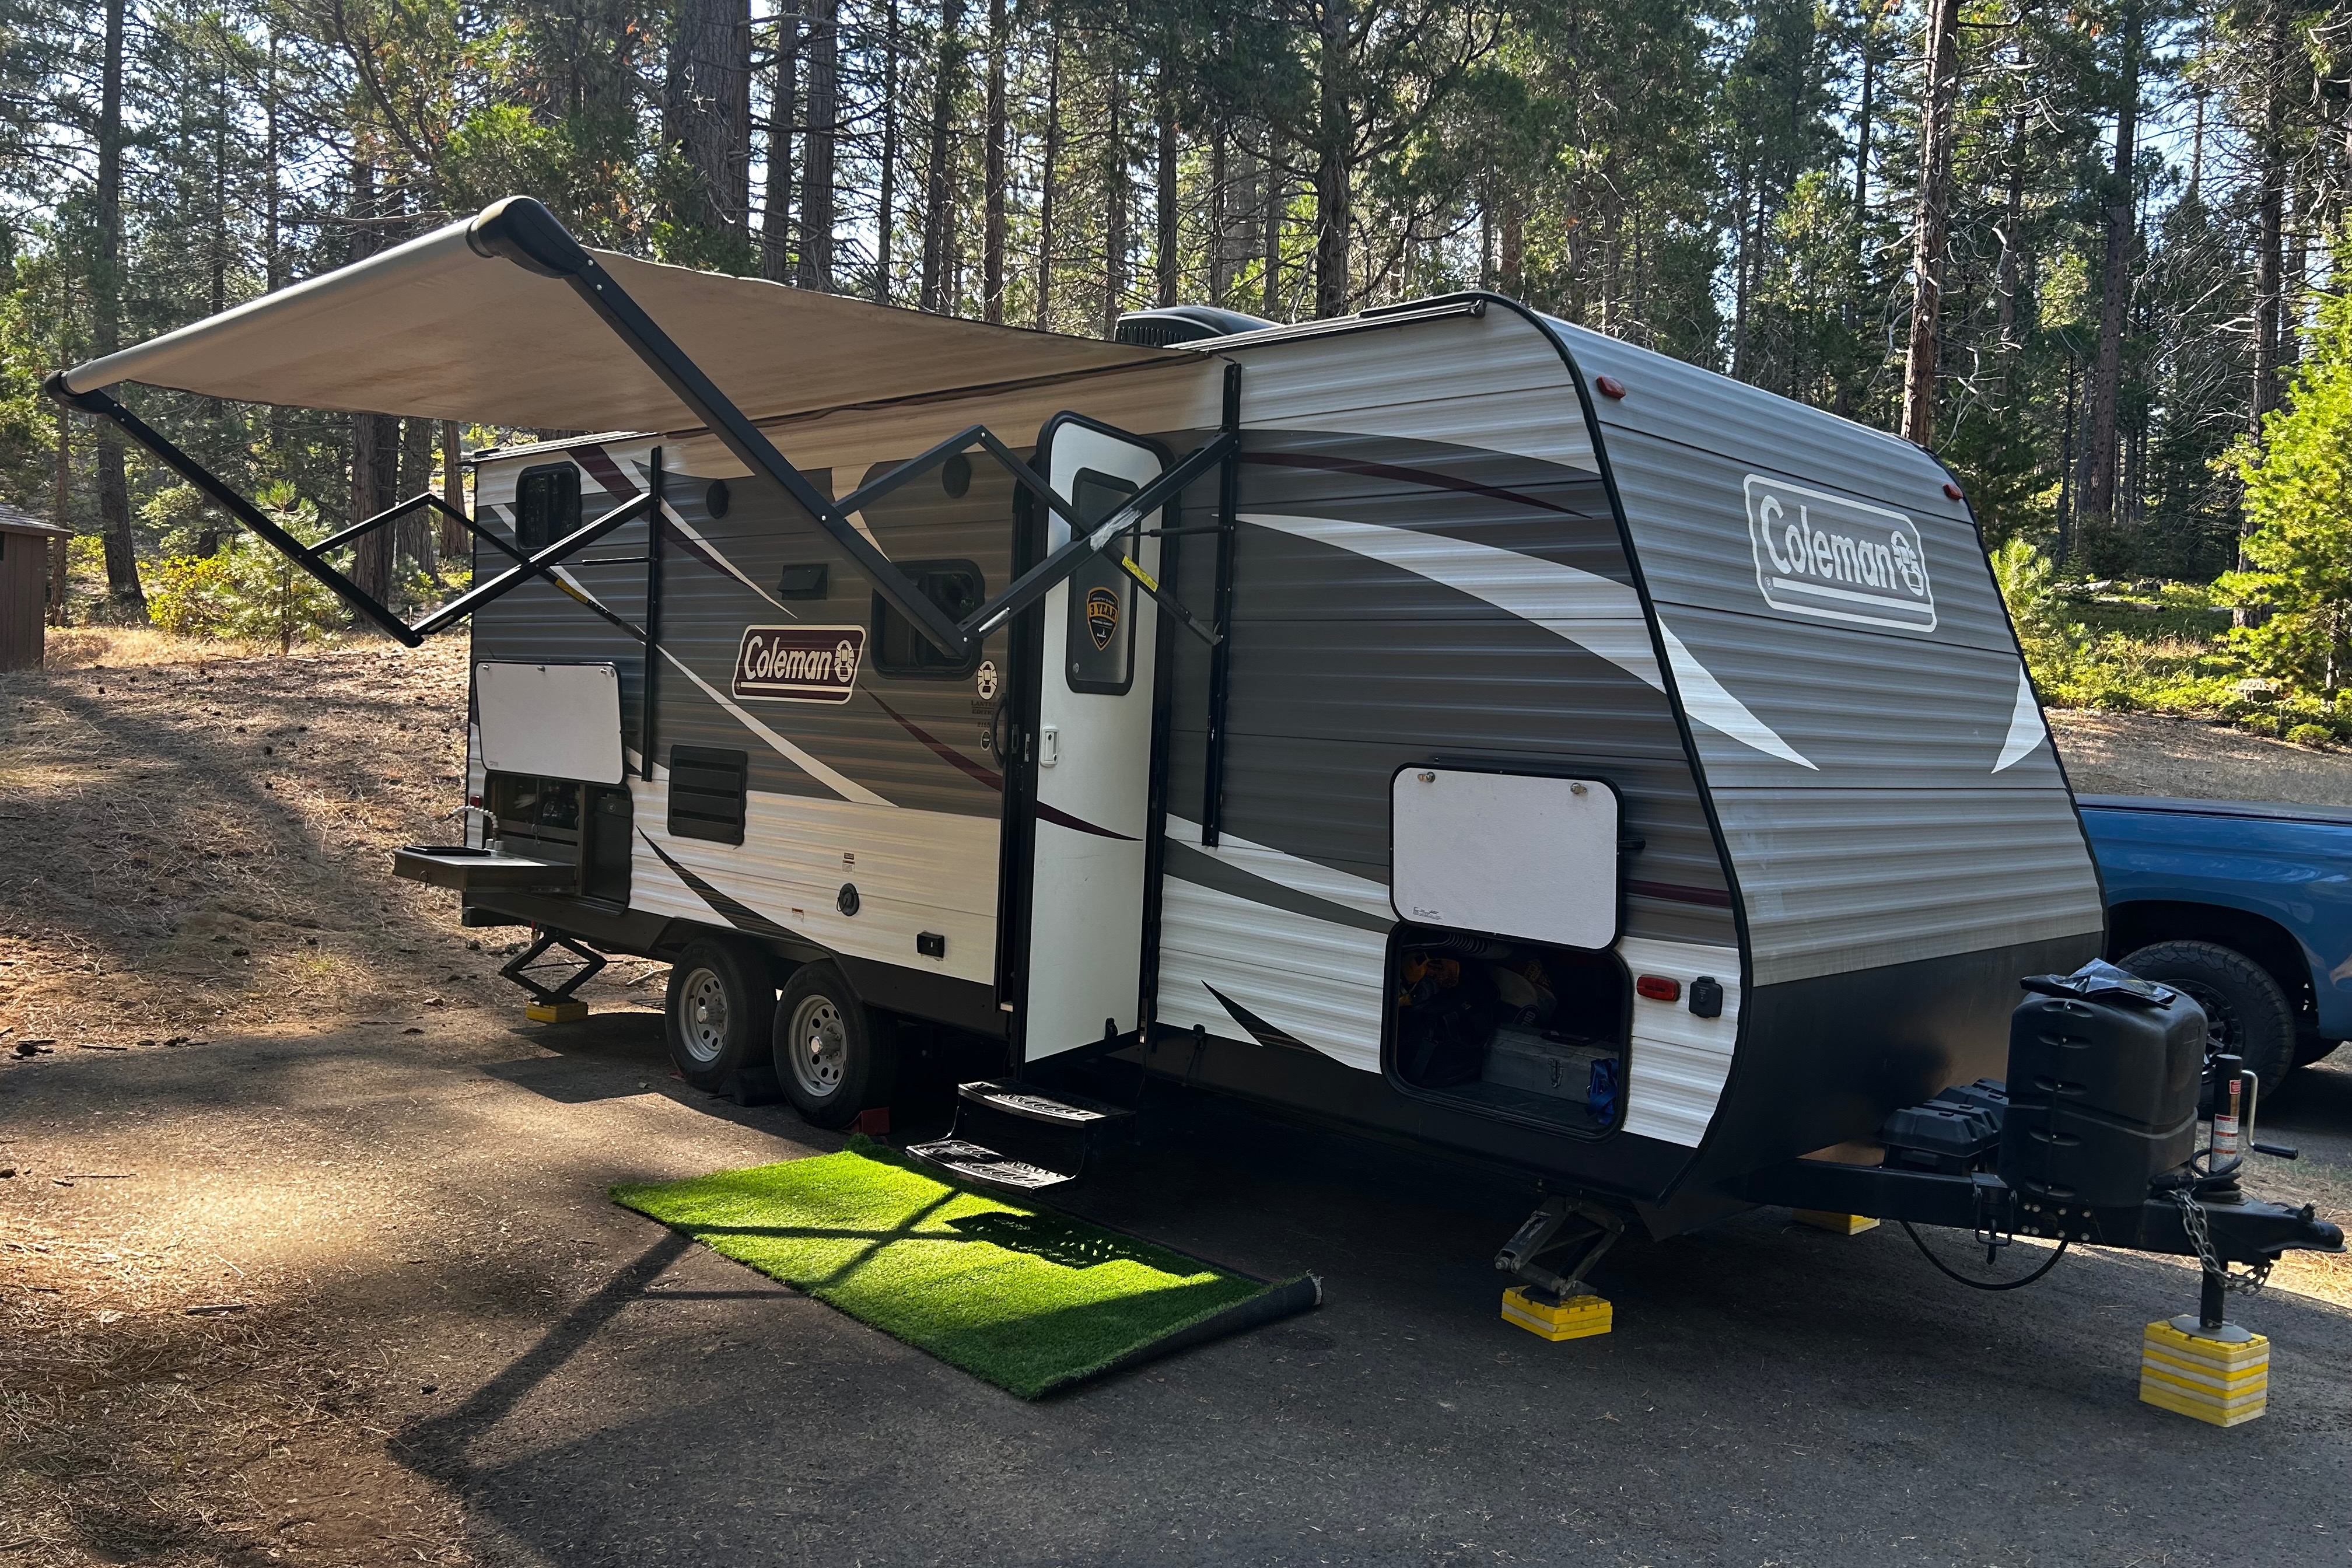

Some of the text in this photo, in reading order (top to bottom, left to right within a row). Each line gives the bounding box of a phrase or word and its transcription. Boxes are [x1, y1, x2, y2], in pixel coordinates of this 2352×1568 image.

[1760, 495, 1898, 590] Coleman
[1090, 603, 1116, 621] 3 YEAR
[744, 635, 832, 680] Coleman
